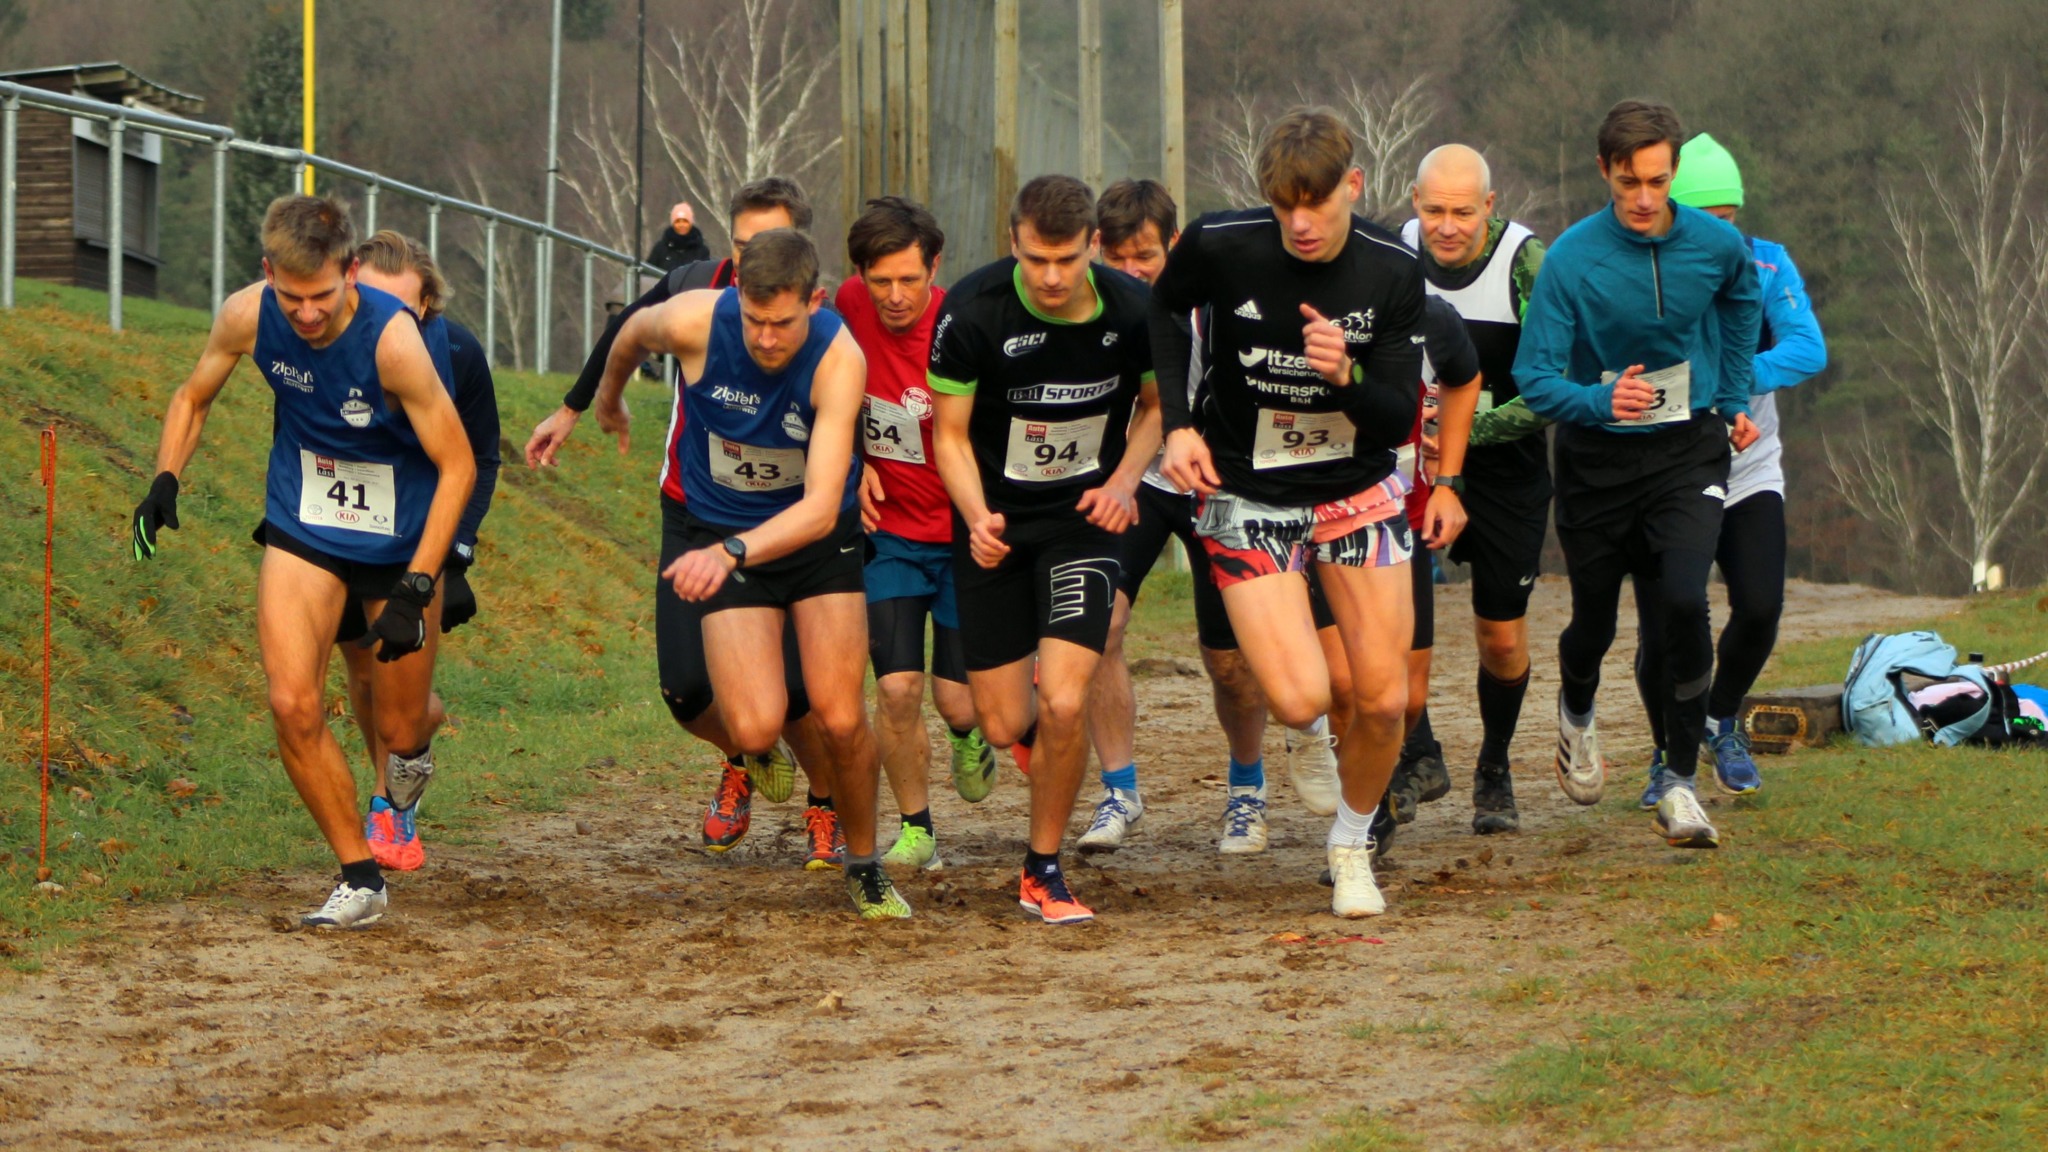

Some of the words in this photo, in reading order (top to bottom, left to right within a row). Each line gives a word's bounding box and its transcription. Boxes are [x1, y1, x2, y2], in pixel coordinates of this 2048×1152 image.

[1267, 349, 1309, 369] Itze
[1044, 379, 1115, 400] SPORTS
[1257, 380, 1331, 397] INTERSPO
[866, 417, 902, 445] 54
[1282, 429, 1329, 449] 93
[1034, 440, 1079, 466] 94
[734, 462, 781, 479] 43
[327, 480, 370, 511] 41
